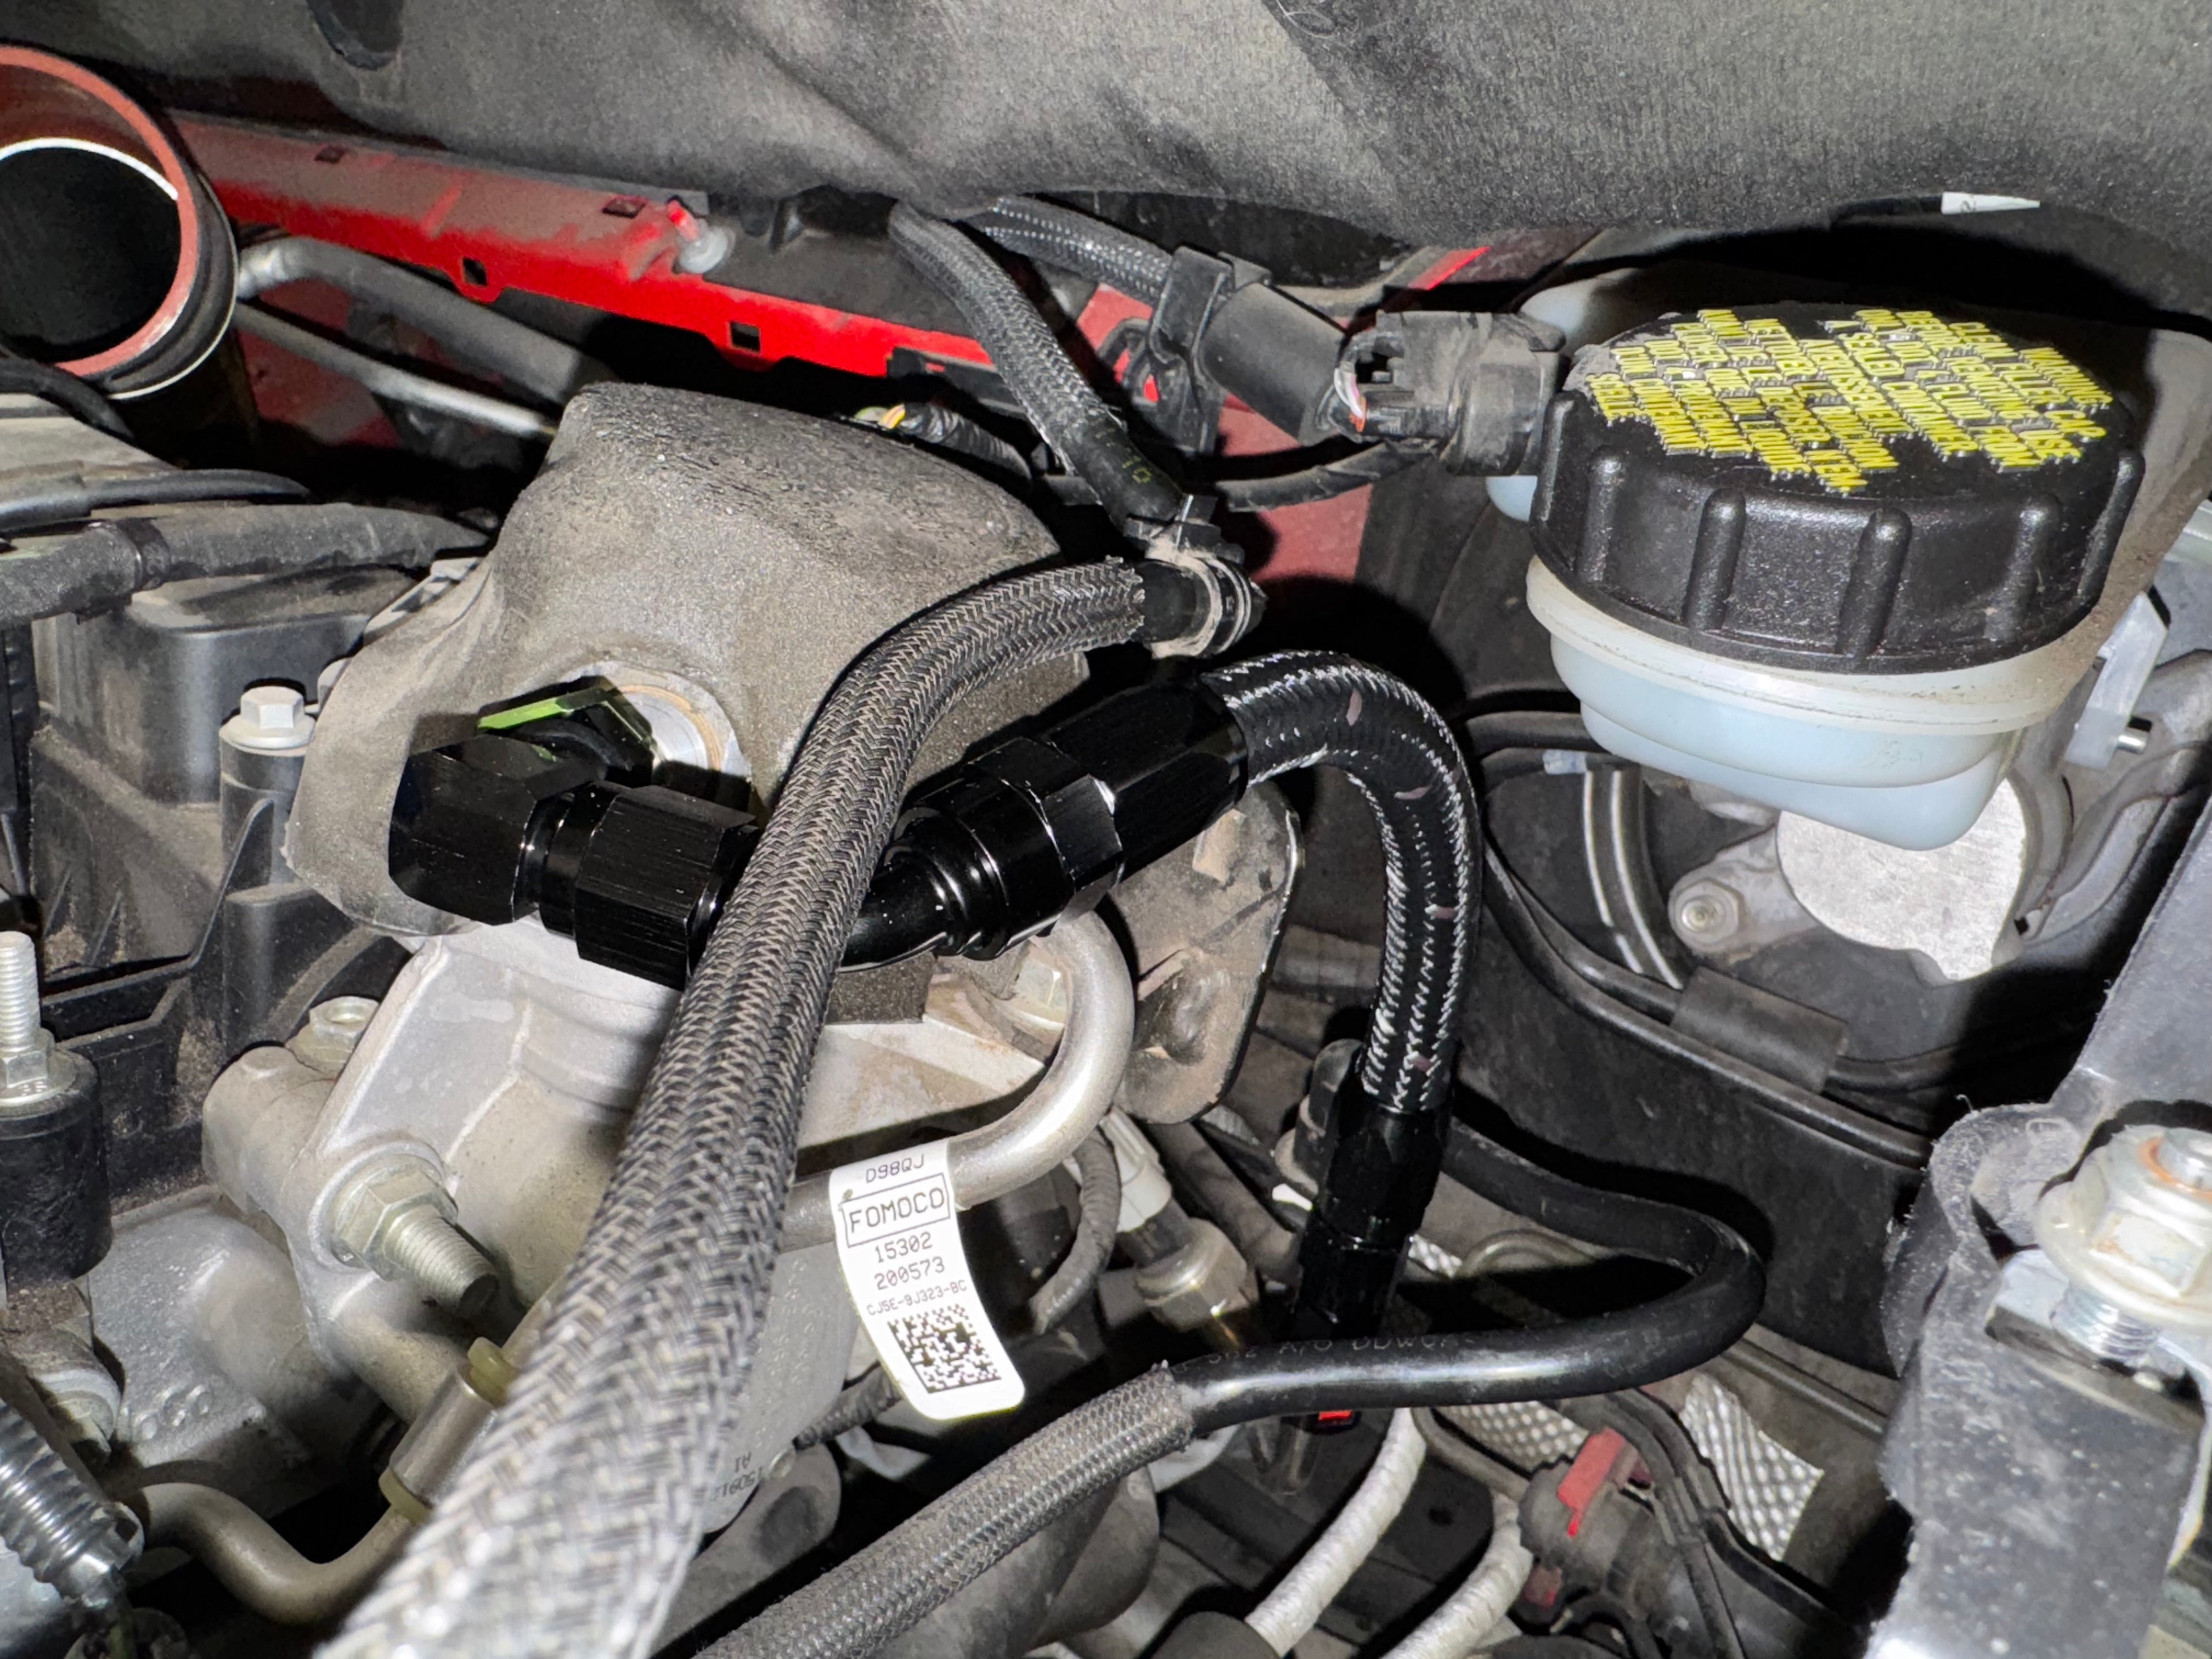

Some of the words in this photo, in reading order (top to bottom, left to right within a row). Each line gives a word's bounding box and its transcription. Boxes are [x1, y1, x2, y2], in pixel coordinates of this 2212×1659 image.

[1671, 323, 1728, 363] PLOYER
[1700, 309, 1753, 339] AVANT
[1726, 345, 1768, 362] DE
[1744, 319, 1818, 376] NETTOYER
[1886, 341, 1938, 365] DOT
[1705, 369, 1751, 392] QUE
[1741, 366, 1784, 381] LE
[1793, 382, 1838, 398] LE
[1799, 339, 1915, 433] AVERTISSEMENT
[1837, 333, 1905, 379] SEALED
[1881, 381, 1978, 454] CONTAINER
[1896, 311, 1972, 352] BEFORE
[1943, 357, 2040, 420] REMOVING
[2019, 430, 2081, 459] USE
[1915, 370, 1951, 381] 4
[1948, 322, 2019, 358] CLEAN
[1993, 363, 2069, 404] FILLER
[2043, 410, 2106, 438] CAP
[2019, 347, 2113, 405] WARNING
[1629, 379, 1707, 450] CONTENANT
[1645, 340, 1689, 360] DOT
[1671, 380, 1753, 453] PROVENANT
[1721, 397, 1768, 415] DU
[1925, 383, 1993, 420] FLUID
[1740, 420, 1812, 473] LIQUIDE
[1811, 406, 1899, 468] BOUCHON
[1967, 426, 2042, 466] FROM
[865, 1154, 925, 1183] D98QJ
[849, 1187, 945, 1233] FOMOCO
[874, 1232, 933, 1263] 15302
[874, 1257, 945, 1290] 200573
